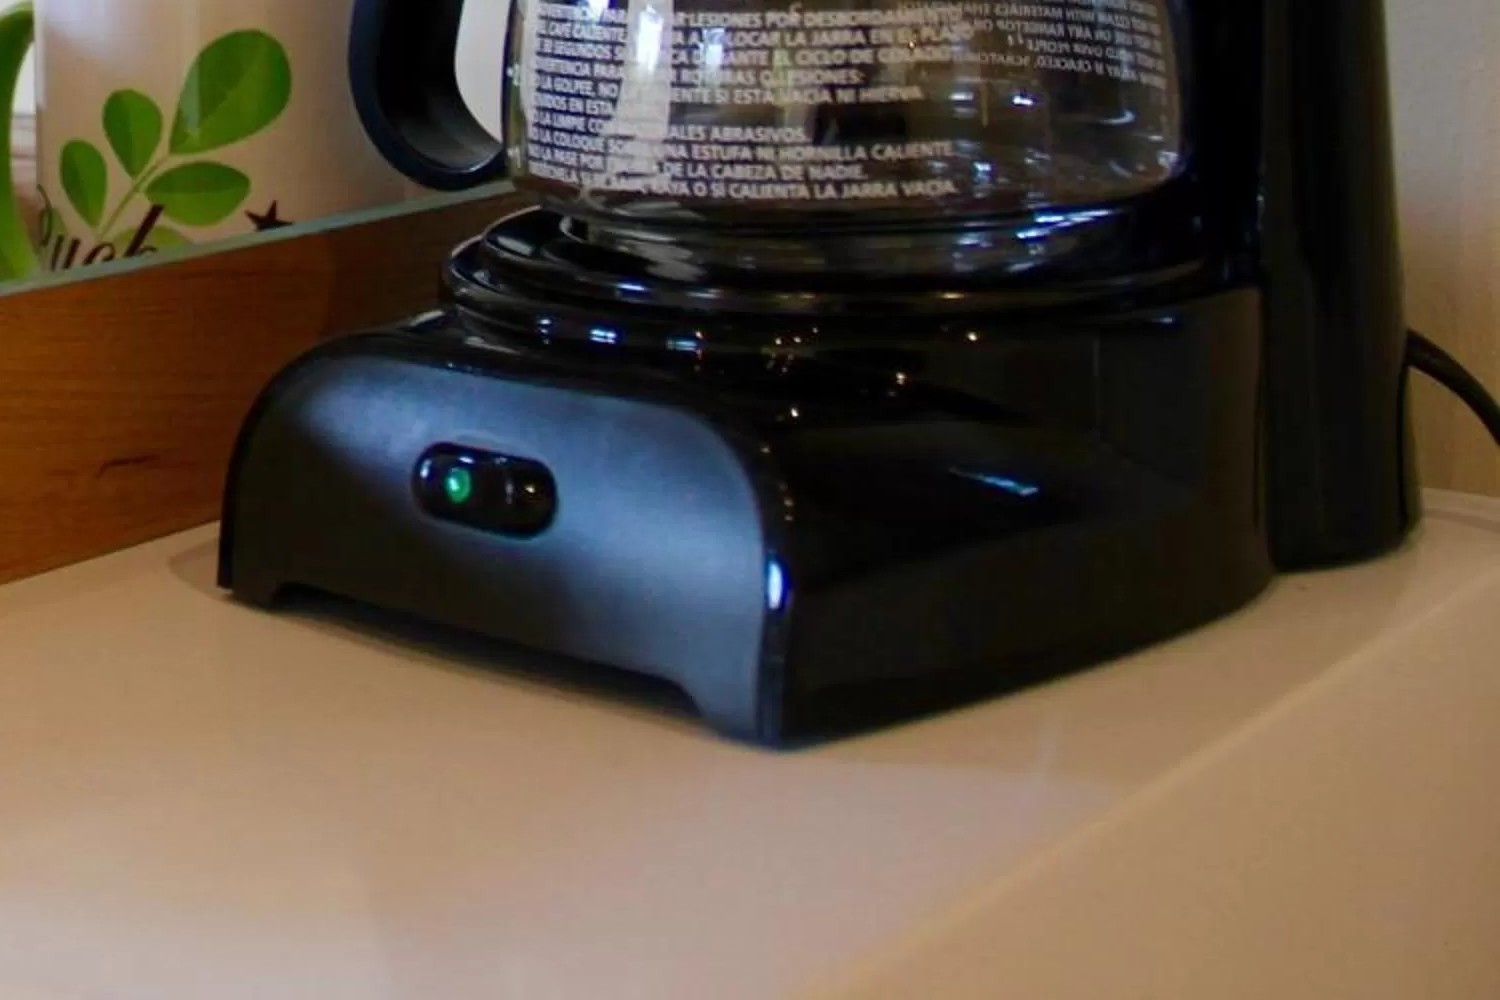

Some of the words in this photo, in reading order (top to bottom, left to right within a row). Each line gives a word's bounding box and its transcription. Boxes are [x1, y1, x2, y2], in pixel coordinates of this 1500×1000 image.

[810, 29, 867, 47] JARRA
[690, 144, 754, 162] ESTUFA
[713, 162, 777, 180] CABEZA
[841, 180, 898, 199] JARRA
